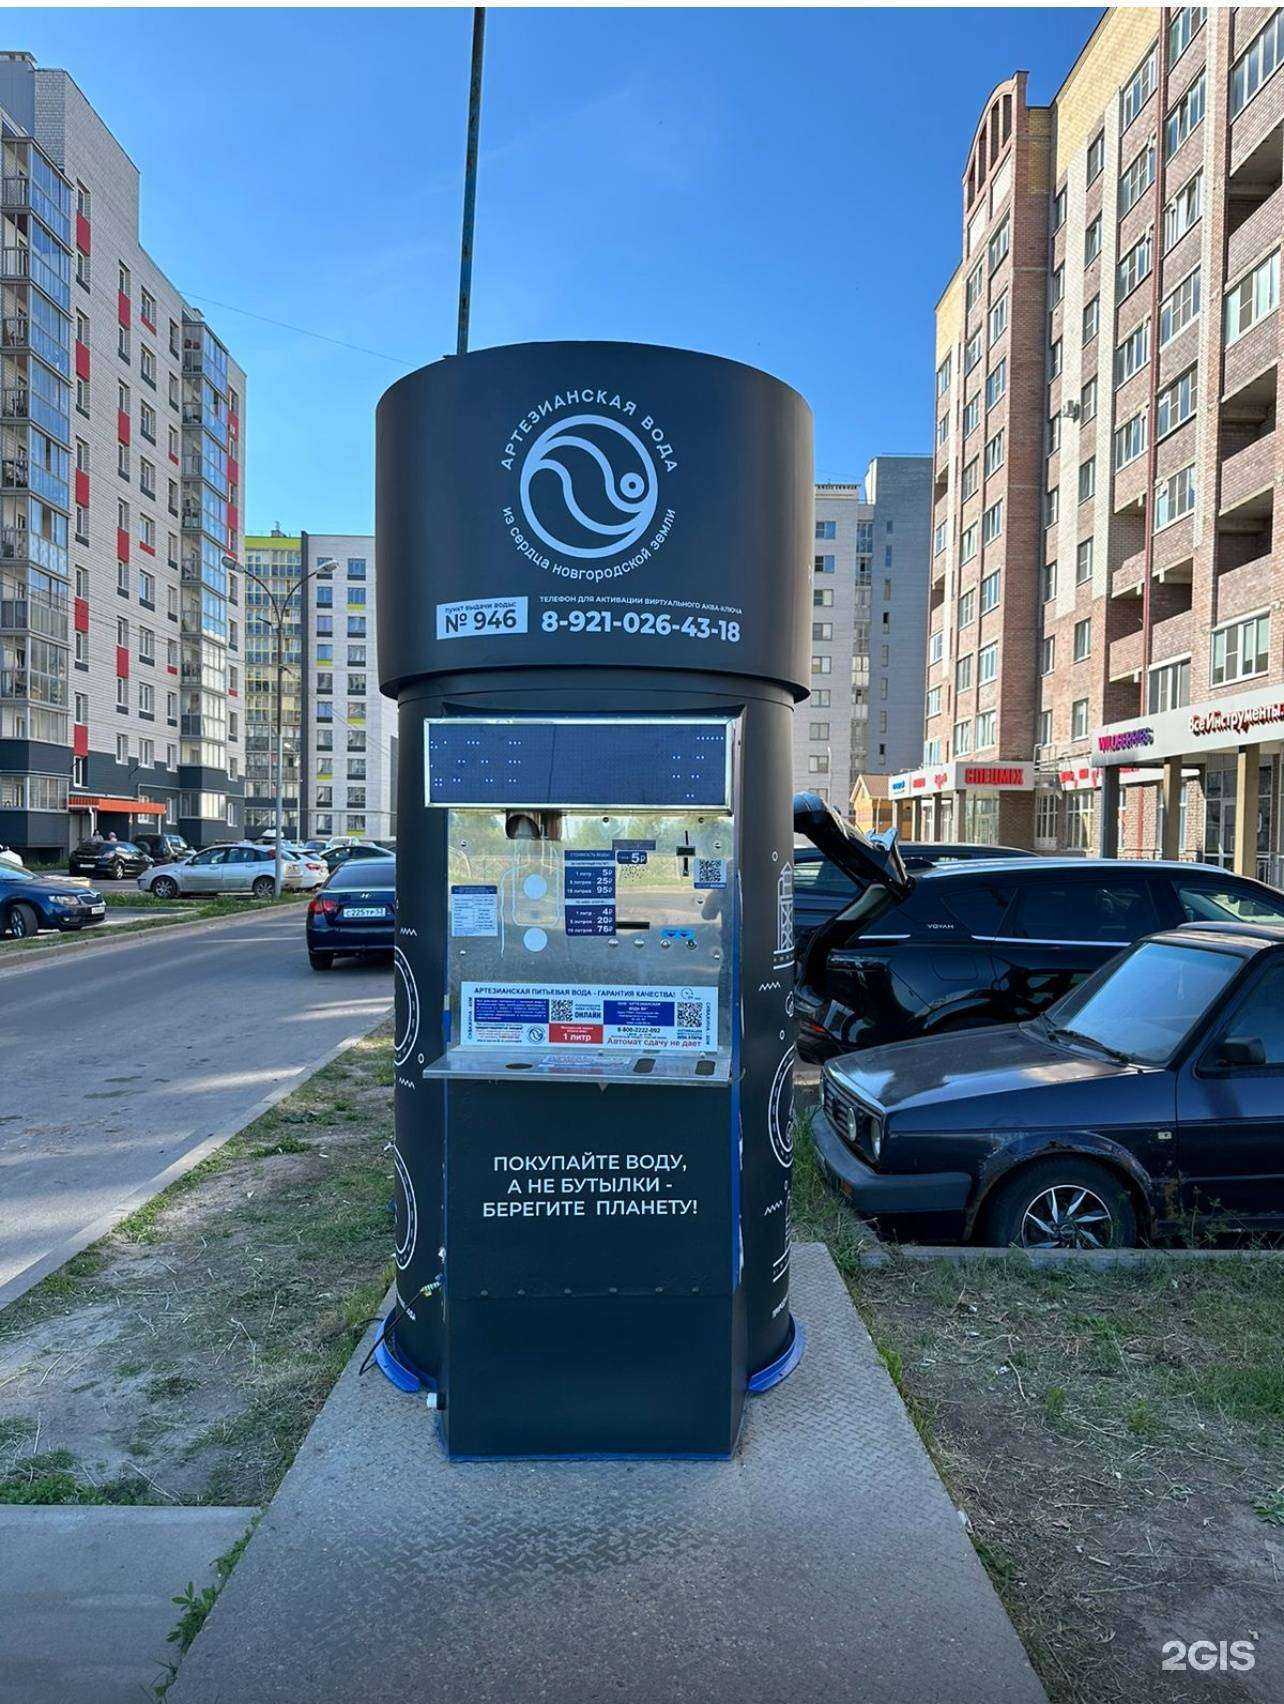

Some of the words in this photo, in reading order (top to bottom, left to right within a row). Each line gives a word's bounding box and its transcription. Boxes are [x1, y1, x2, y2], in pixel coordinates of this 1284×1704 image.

[501, 389, 637, 470] АРТЕЗИАНСКАЯ
[641, 415, 678, 472] ВОДА
[502, 507, 515, 525] из
[510, 526, 550, 569] сердца
[552, 548, 651, 583] новгородской
[650, 509, 676, 550] земли
[539, 595, 577, 603] ТЕЛЕФОН
[578, 596, 595, 604] ДЛЯ
[596, 596, 643, 605] АКТИВАЦИИ
[645, 598, 700, 608] ВИРТУАЛЬНОГО
[445, 612, 467, 634] №
[474, 609, 517, 631] 946
[541, 610, 741, 643] 8-921-026-43-18
[532, 988, 570, 996] ПИТЬЕВАЯ
[574, 1011, 601, 1019] ОНЛАЙН
[570, 1034, 592, 1042] литр
[608, 1038, 641, 1046] Автомат
[494, 1151, 620, 1171] ПОКУПАЙТЕ
[626, 1154, 687, 1172] ВОДУ,
[507, 1178, 522, 1194] А
[528, 1178, 555, 1193] НЕ
[561, 1177, 660, 1193] БУТЫЛКИ
[482, 1201, 585, 1217] БЕРЕГИТЕ
[596, 1200, 698, 1216] ПЛАНЕТУ!
